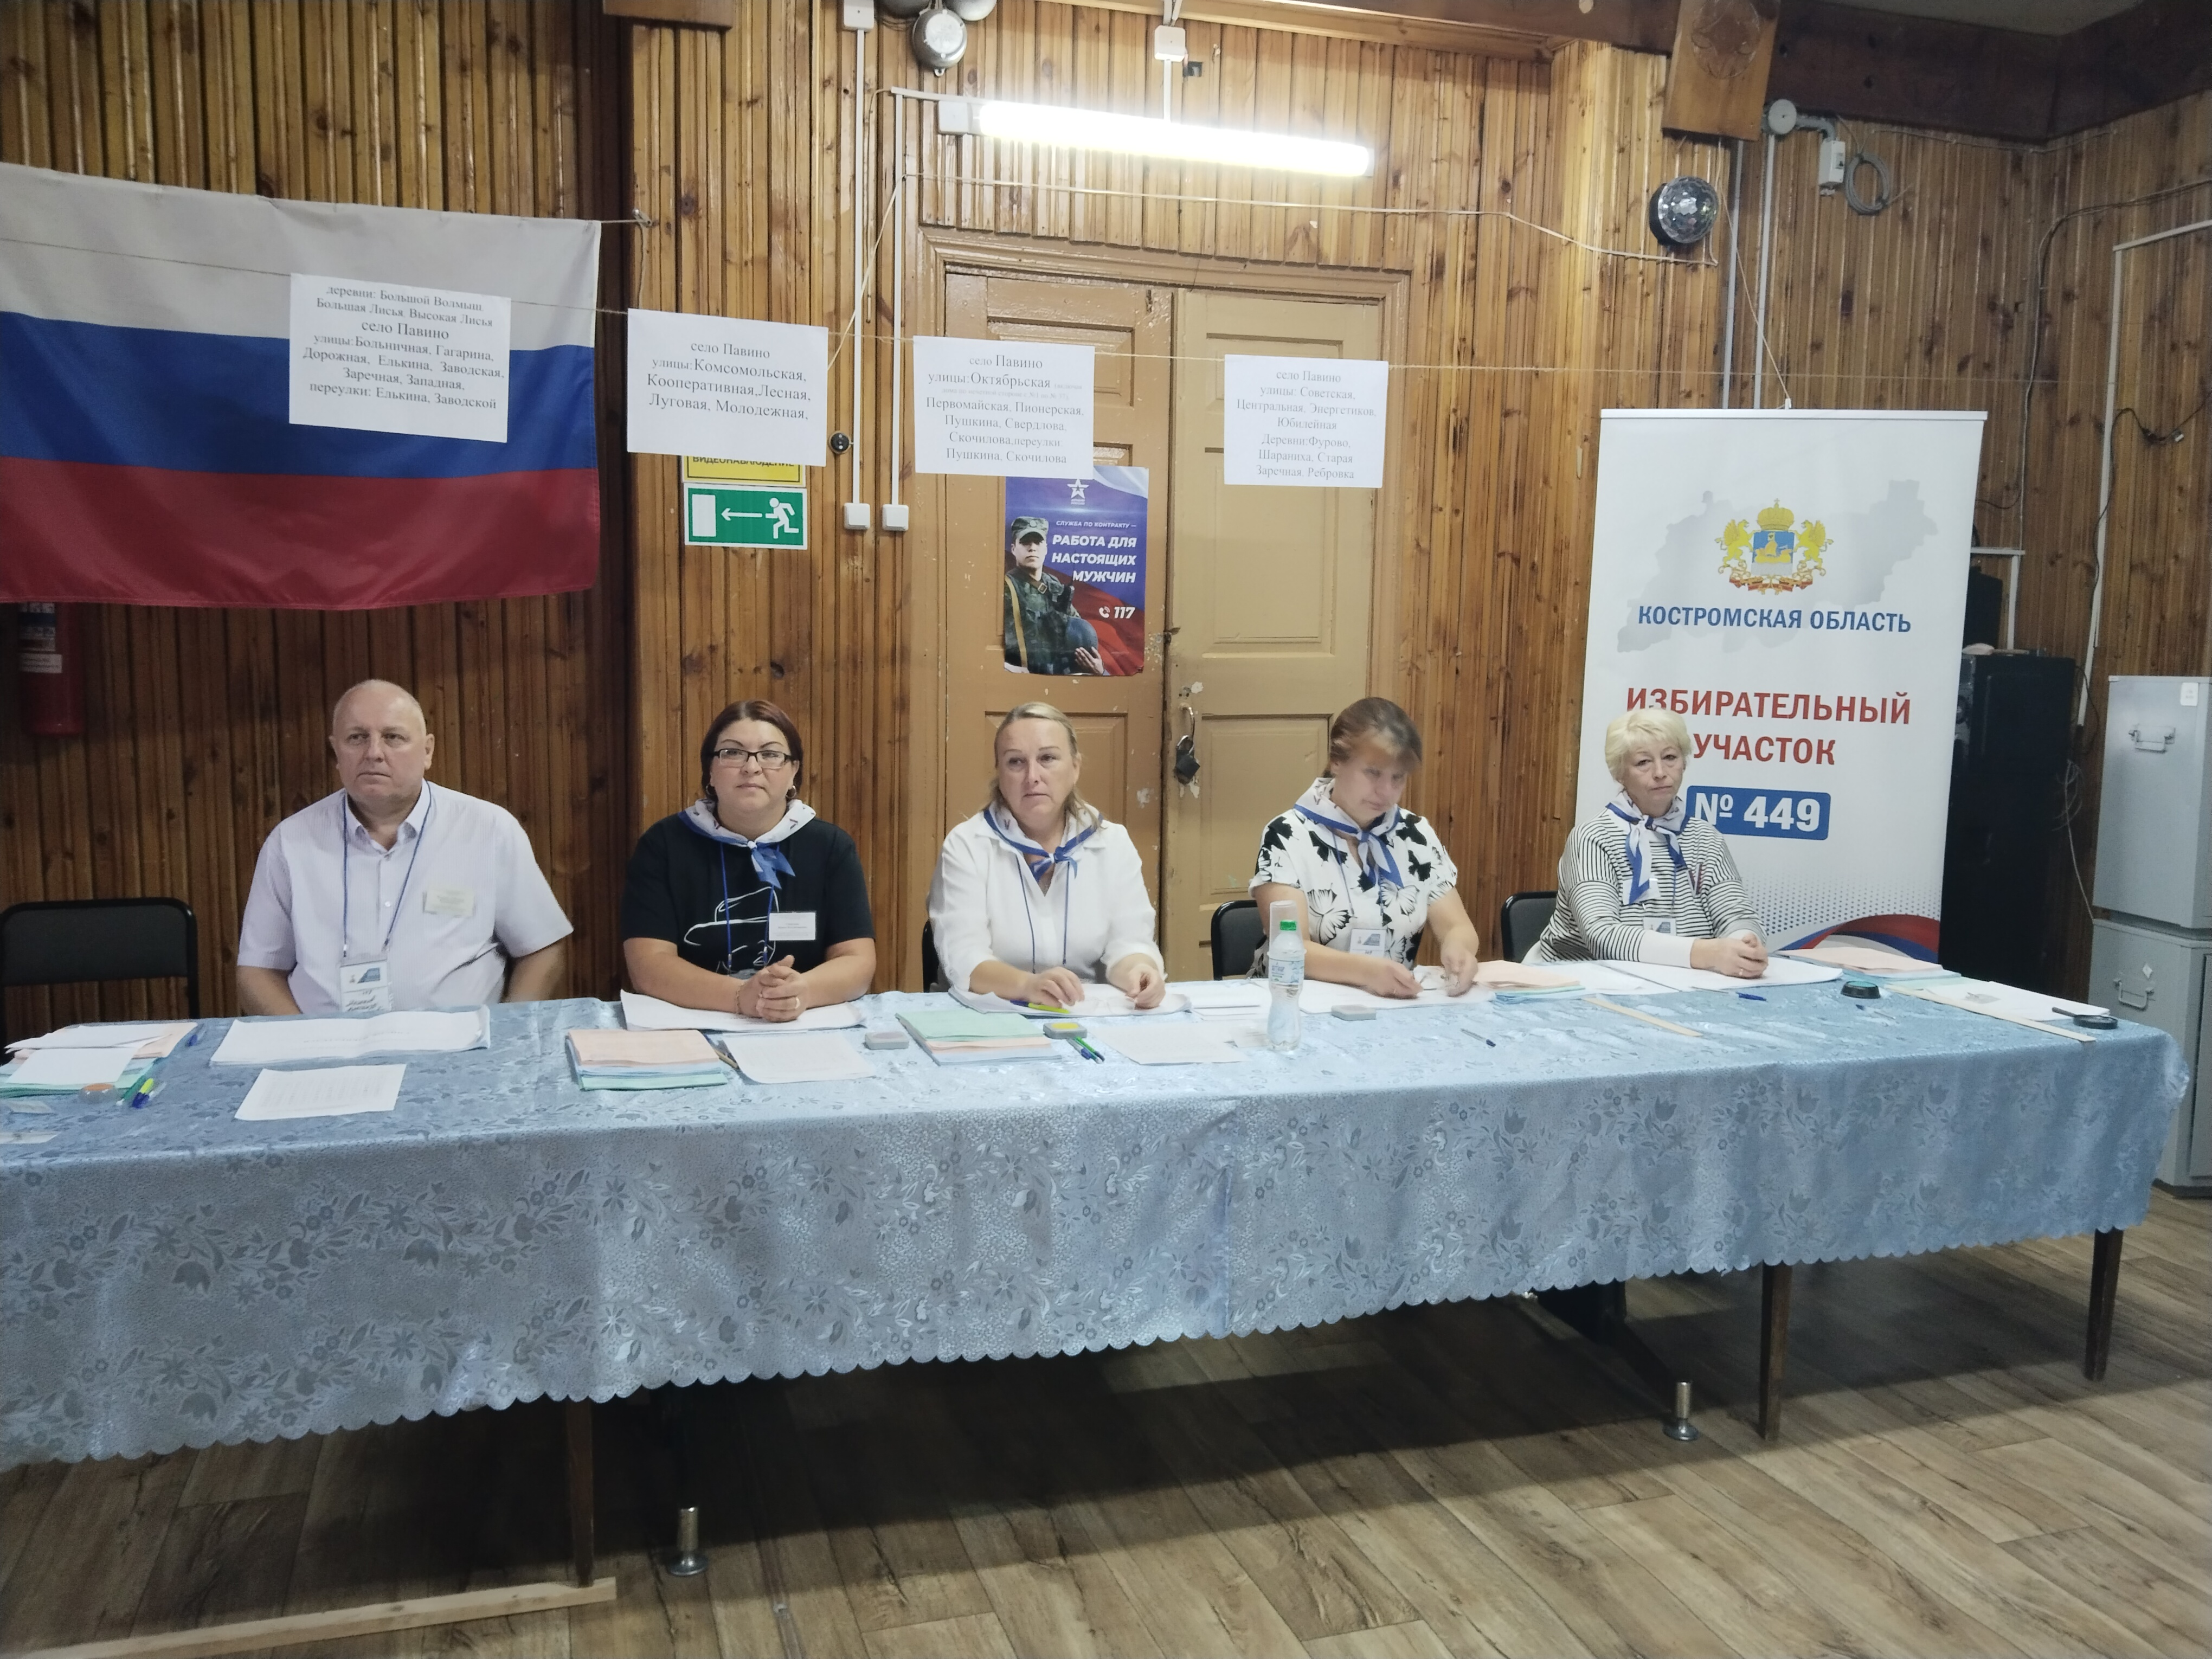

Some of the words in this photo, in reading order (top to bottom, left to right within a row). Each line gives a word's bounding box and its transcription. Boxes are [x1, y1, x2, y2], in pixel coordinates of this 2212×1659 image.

[326, 286, 376, 299] деревни:
[381, 290, 429, 305] Большой
[317, 298, 365, 312] Большая
[409, 308, 456, 323] Высокая
[460, 314, 492, 327] Лисья
[362, 321, 392, 333] село
[398, 323, 449, 339] Павино
[436, 345, 494, 362] Гагарина,
[691, 342, 718, 353] село
[723, 343, 770, 359] Павино
[303, 347, 370, 365] Дорожная,
[378, 355, 433, 371] Елькина,
[440, 362, 505, 378] Заводская,
[969, 357, 992, 366] село
[996, 355, 1043, 369] Павино
[407, 374, 465, 390] Западная,
[1276, 371, 1299, 380] село
[1303, 370, 1341, 382] Павино
[310, 382, 371, 397] переулки:
[377, 387, 430, 403] Елькина,
[434, 393, 496, 409] Заводской
[1260, 386, 1296, 396] улицы:
[1300, 387, 1355, 400] Советская,
[649, 394, 710, 411] Луговая,
[716, 400, 808, 420] Молодежная,
[927, 397, 1011, 411] Первомайская,
[1015, 402, 1084, 416] Пионерская,
[1237, 399, 1306, 413] Центральная,
[1310, 403, 1376, 416] Энергетиков,
[945, 415, 1001, 429] Пушкина,
[1005, 418, 1066, 432] Свердлова,
[1278, 417, 1336, 429] Юбилейная
[947, 448, 1002, 462] Пушкина,
[1318, 453, 1353, 465] Старая
[1308, 468, 1354, 480] Ребровка
[1052, 535, 1105, 546] РАБОТА
[1108, 537, 1136, 549] ДЛЯ
[1052, 553, 1136, 566] НАСТОЯЩИХ
[1072, 571, 1136, 583] МУЖЧИН
[1114, 607, 1135, 619] 117
[1638, 606, 1802, 628] КОСТРОМСКАЯ
[1810, 610, 1911, 632] ОБЛАСТЬ
[1627, 688, 1911, 724] ИЗБИРАТЕЛЬНЫЙ
[1693, 734, 1835, 765] УЧАСТОК
[1694, 793, 1733, 826] №
[1744, 796, 1821, 832] 449
